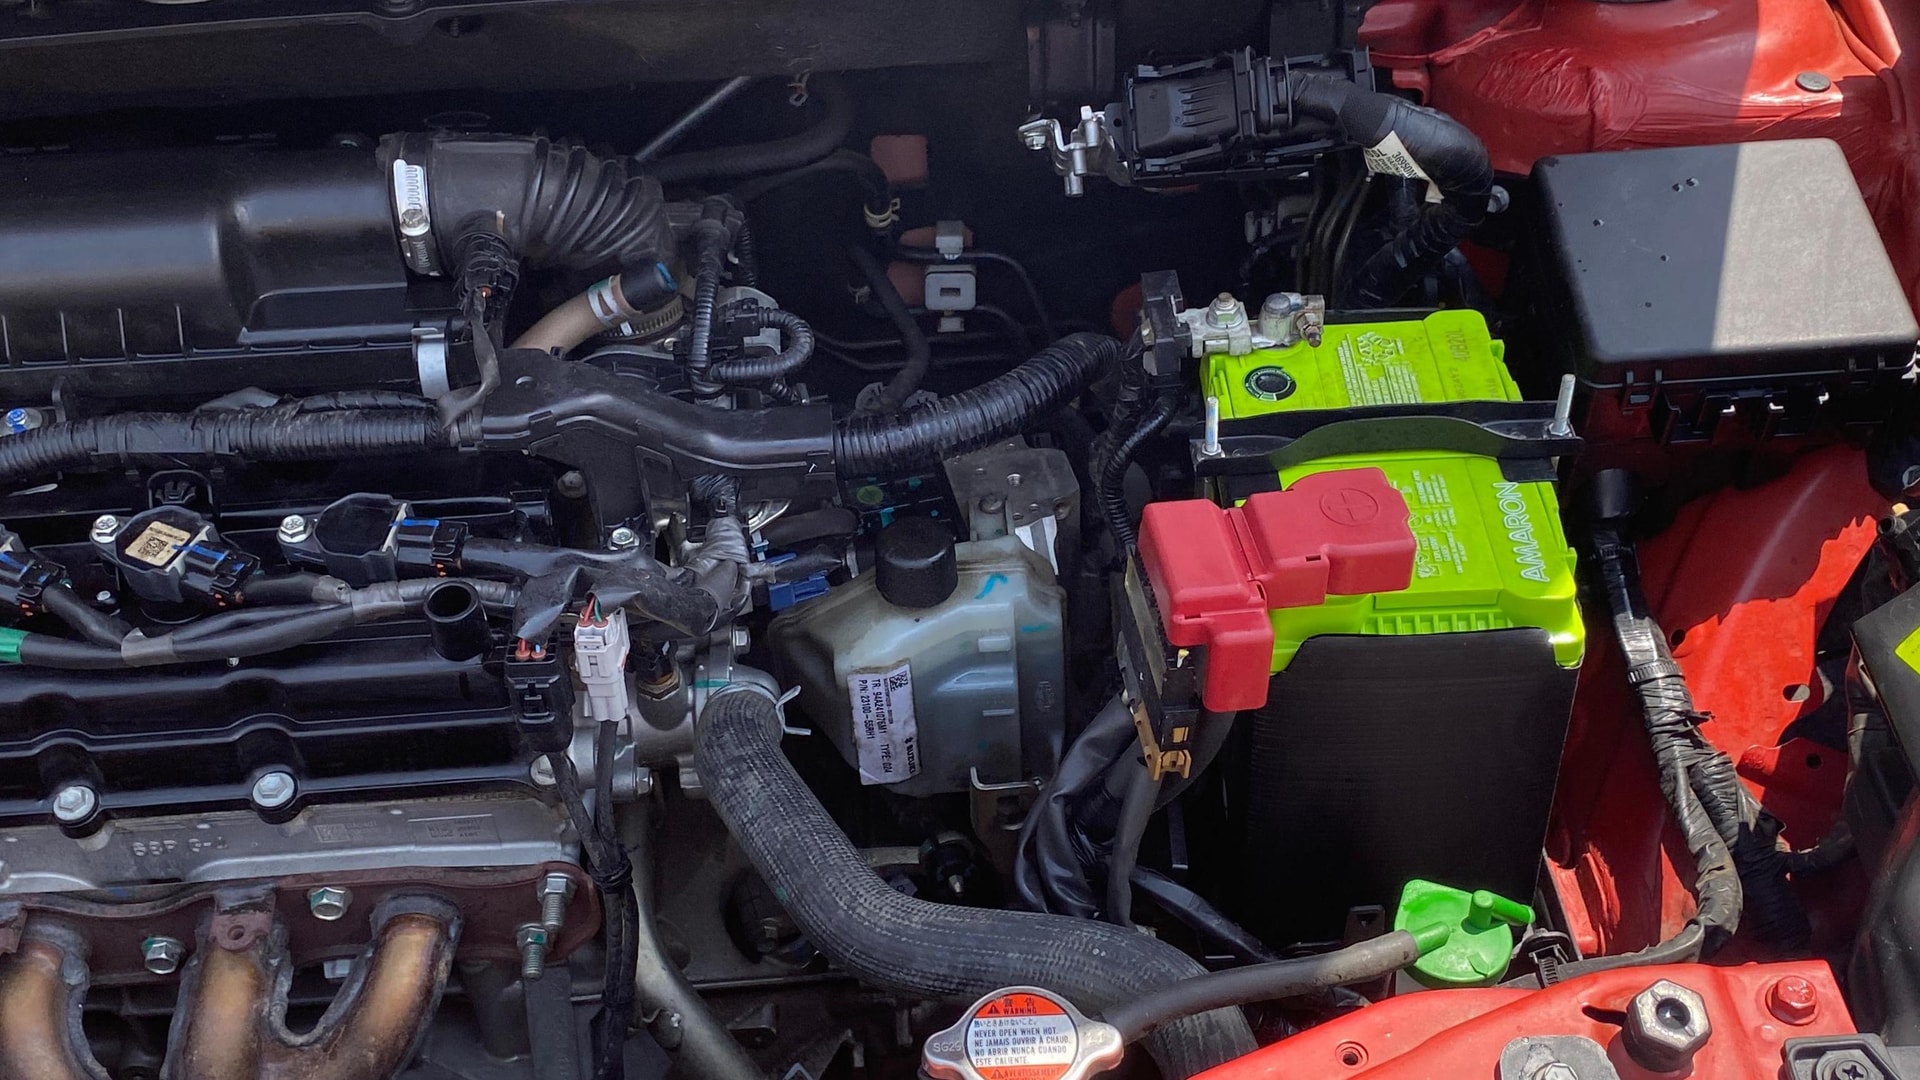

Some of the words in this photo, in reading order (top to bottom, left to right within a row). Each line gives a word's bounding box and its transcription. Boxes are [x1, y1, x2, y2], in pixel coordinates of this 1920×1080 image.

[1492, 481, 1551, 584] AMARON
[906, 744, 916, 774] SUZUKI
[1003, 1006, 1037, 1016] WARNING
[974, 1029, 996, 1038] NEVER
[999, 1028, 1018, 1037] OPEN
[1020, 1027, 1041, 1036] WHEN
[1043, 1026, 1059, 1035] HOT.
[974, 1039, 983, 1047] NE
[986, 1037, 1010, 1046] JAMAIS
[1012, 1036, 1036, 1045] OUVRIR
[975, 1048, 985, 1057] NO
[987, 1047, 1009, 1056] ABRIR
[1011, 1046, 1036, 1055] NUNCA
[1038, 1045, 1067, 1054] CUANDO
[975, 1057, 992, 1066] ESTE
[994, 1055, 1029, 1065] CALIENTE.
